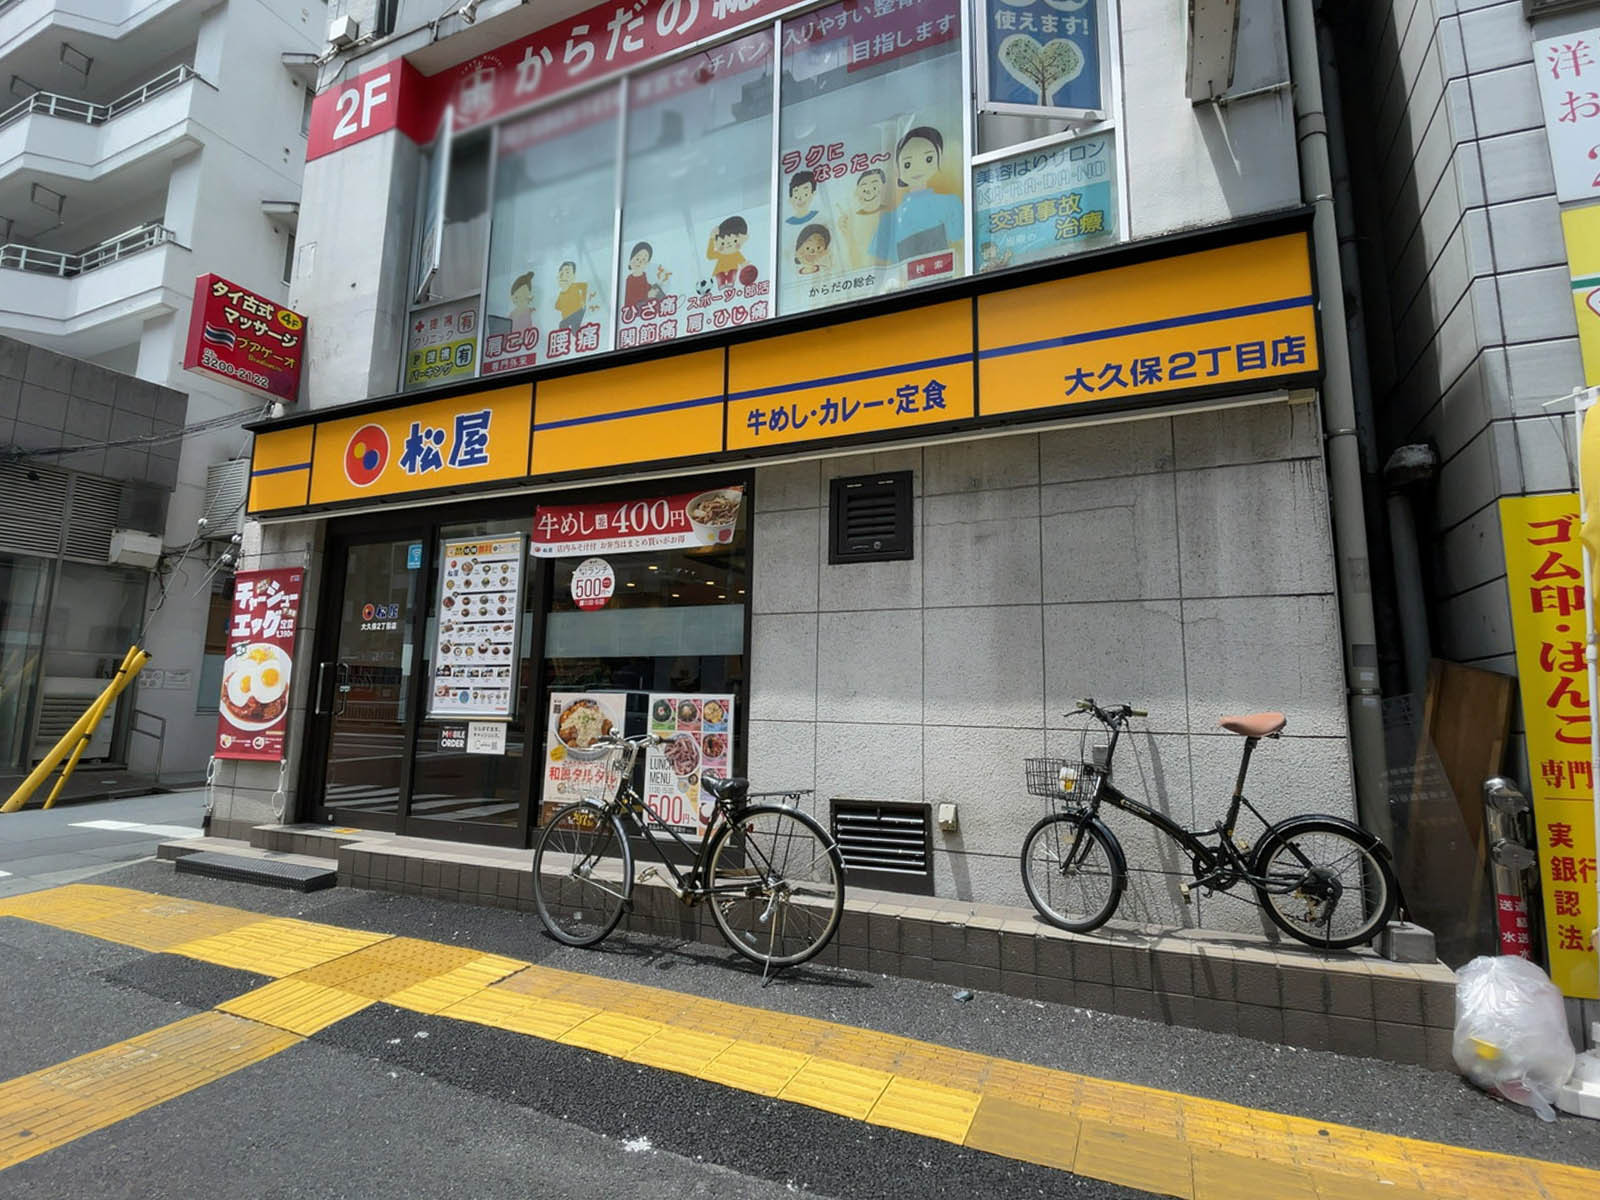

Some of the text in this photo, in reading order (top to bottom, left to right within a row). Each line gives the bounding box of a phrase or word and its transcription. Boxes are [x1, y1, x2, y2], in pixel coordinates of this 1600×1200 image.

[994, 10, 1089, 35] 使えます!
[852, 14, 956, 63] 目指します
[333, 74, 391, 140] 2F
[782, 142, 844, 174] ラクに
[989, 192, 1082, 233] 交通事故
[1055, 210, 1104, 241] 治療
[213, 281, 275, 320] タイ古式
[808, 274, 876, 298] からだの総合
[281, 312, 299, 328] 4F
[621, 295, 679, 324] ひざ痛
[686, 301, 768, 334] 肩・ひじ痛
[224, 305, 298, 348] マッサージ
[413, 330, 453, 347] クリニック
[547, 322, 600, 359] 腰痛
[619, 319, 678, 348] 関節痛
[485, 327, 539, 358] 肩こり
[202, 353, 269, 388] 3200-2122
[1064, 335, 1307, 396] 大久保2丁目店
[747, 380, 948, 437] 牛めし・カレー・定食
[399, 408, 493, 476] 松屋
[537, 511, 594, 540] 牛めし
[611, 499, 686, 534] 400円
[235, 581, 299, 611] チャーシュー
[231, 609, 282, 639] エッグ
[1527, 513, 1591, 743] ゴム印・はんこ
[441, 738, 465, 748] ORDER
[649, 772, 671, 784] MENU
[650, 758, 672, 770] LUNCH
[1541, 760, 1593, 790] 専門
[1558, 924, 1594, 952] 法
